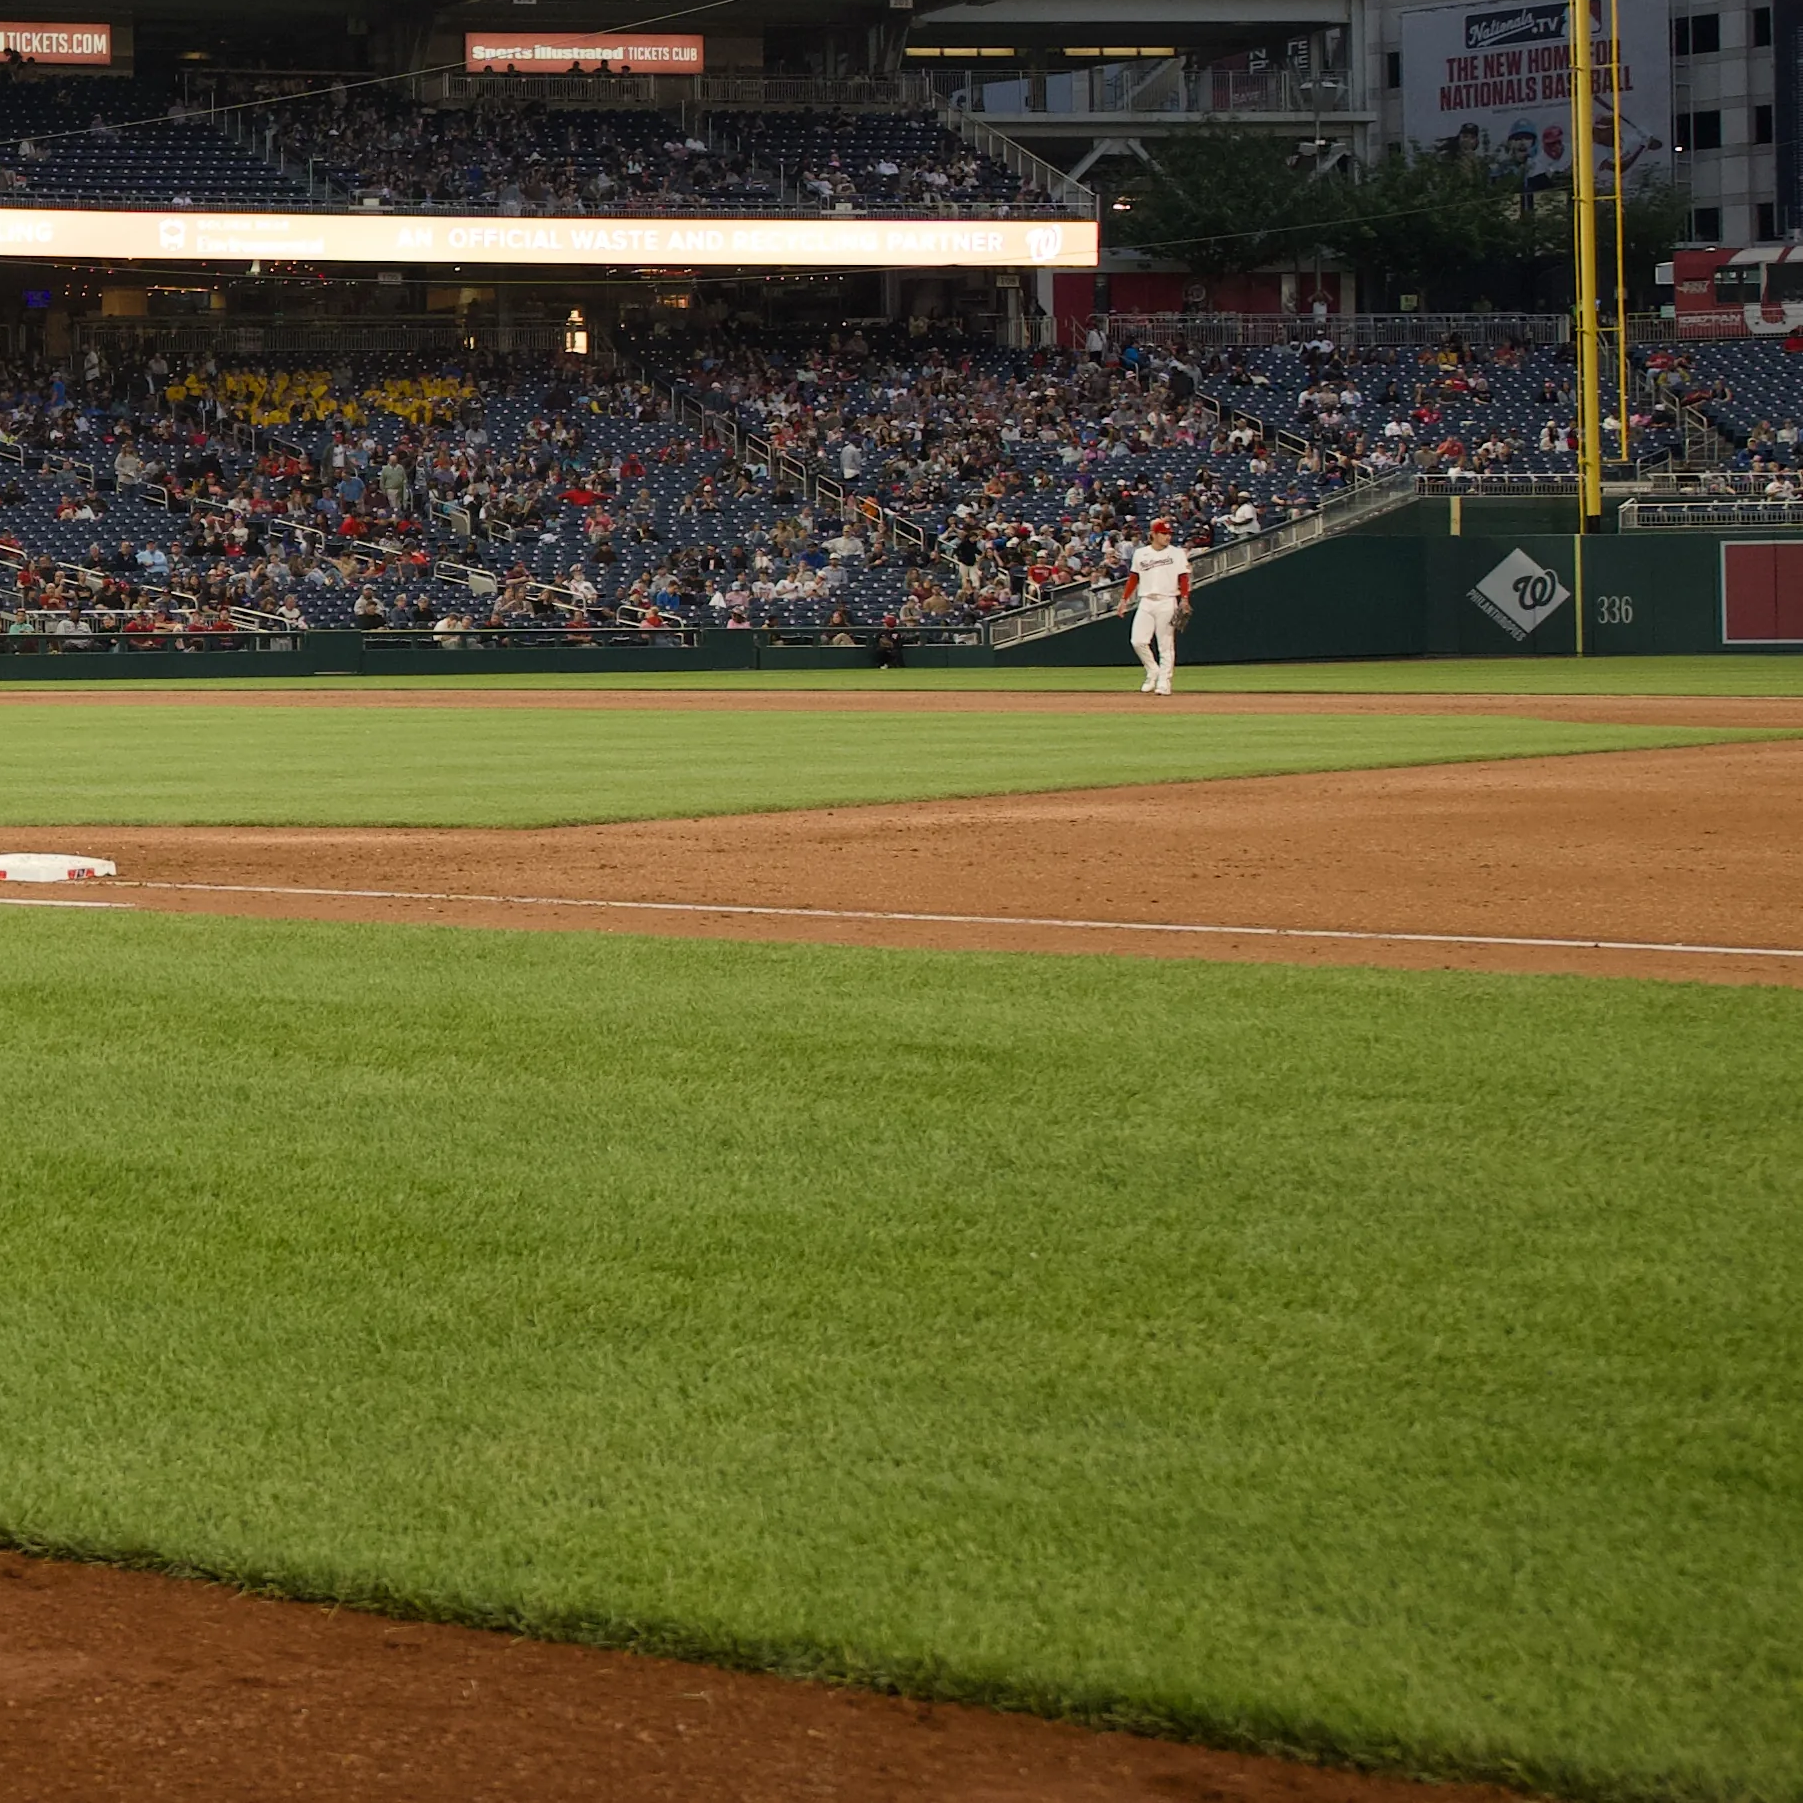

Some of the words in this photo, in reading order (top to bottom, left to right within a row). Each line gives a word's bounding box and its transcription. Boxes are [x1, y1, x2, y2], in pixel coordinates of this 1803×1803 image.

[6, 32, 107, 54] TICKETS.COM
[472, 46, 532, 60] Sports
[534, 44, 624, 61] Illustrated
[629, 47, 670, 61] TICKETS
[673, 47, 698, 61] CLUB
[1447, 56, 1478, 83] THE
[1484, 50, 1522, 79] NEW
[1528, 44, 1577, 76] HOM
[1440, 77, 1536, 111] NATIONALS
[1541, 65, 1634, 100] BASBALL
[396, 226, 433, 248] AN
[448, 227, 563, 250] OFFICIAL
[570, 230, 659, 251] WASTE
[667, 230, 724, 252] AND
[886, 232, 1004, 253] PARTNER
[1466, 588, 1528, 642] PHILANTHROPIES
[1597, 595, 1634, 624] 336
